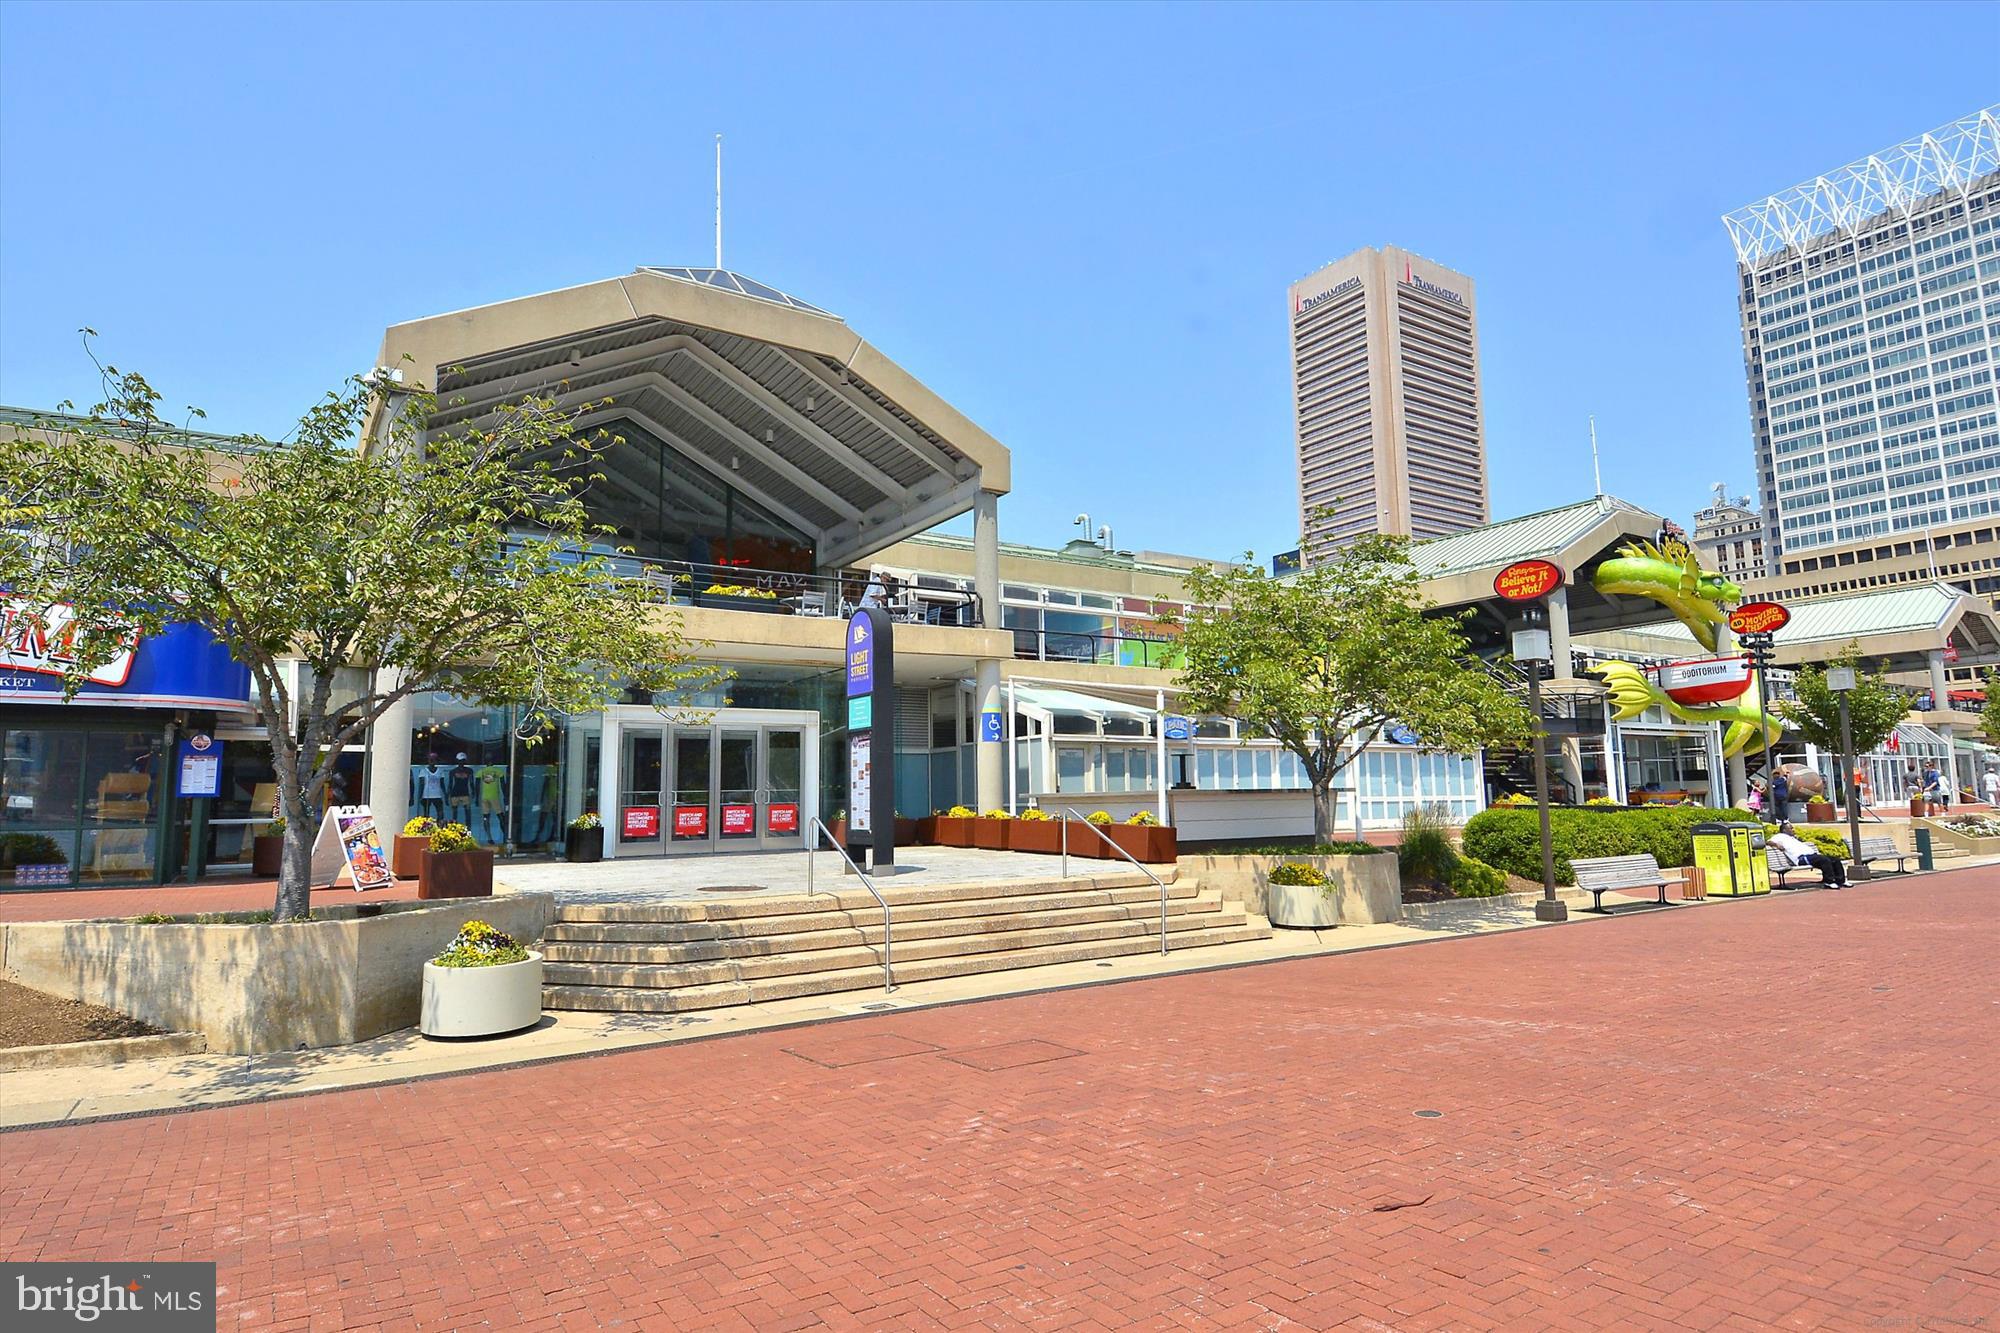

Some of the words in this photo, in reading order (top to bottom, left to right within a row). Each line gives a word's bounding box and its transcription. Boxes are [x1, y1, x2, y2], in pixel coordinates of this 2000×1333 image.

[1303, 275, 1360, 309] TRANSAMERICA
[1413, 274, 1463, 304] TRANSAMERICA
[1501, 575, 1536, 588] Believe
[1538, 569, 1548, 581] It
[1508, 588, 1520, 597] or
[1521, 581, 1543, 595] Not!
[1745, 607, 1779, 625] MOVING
[1745, 613, 1783, 632] THEATER
[850, 650, 869, 665] LIGHT
[850, 664, 869, 676] STREET
